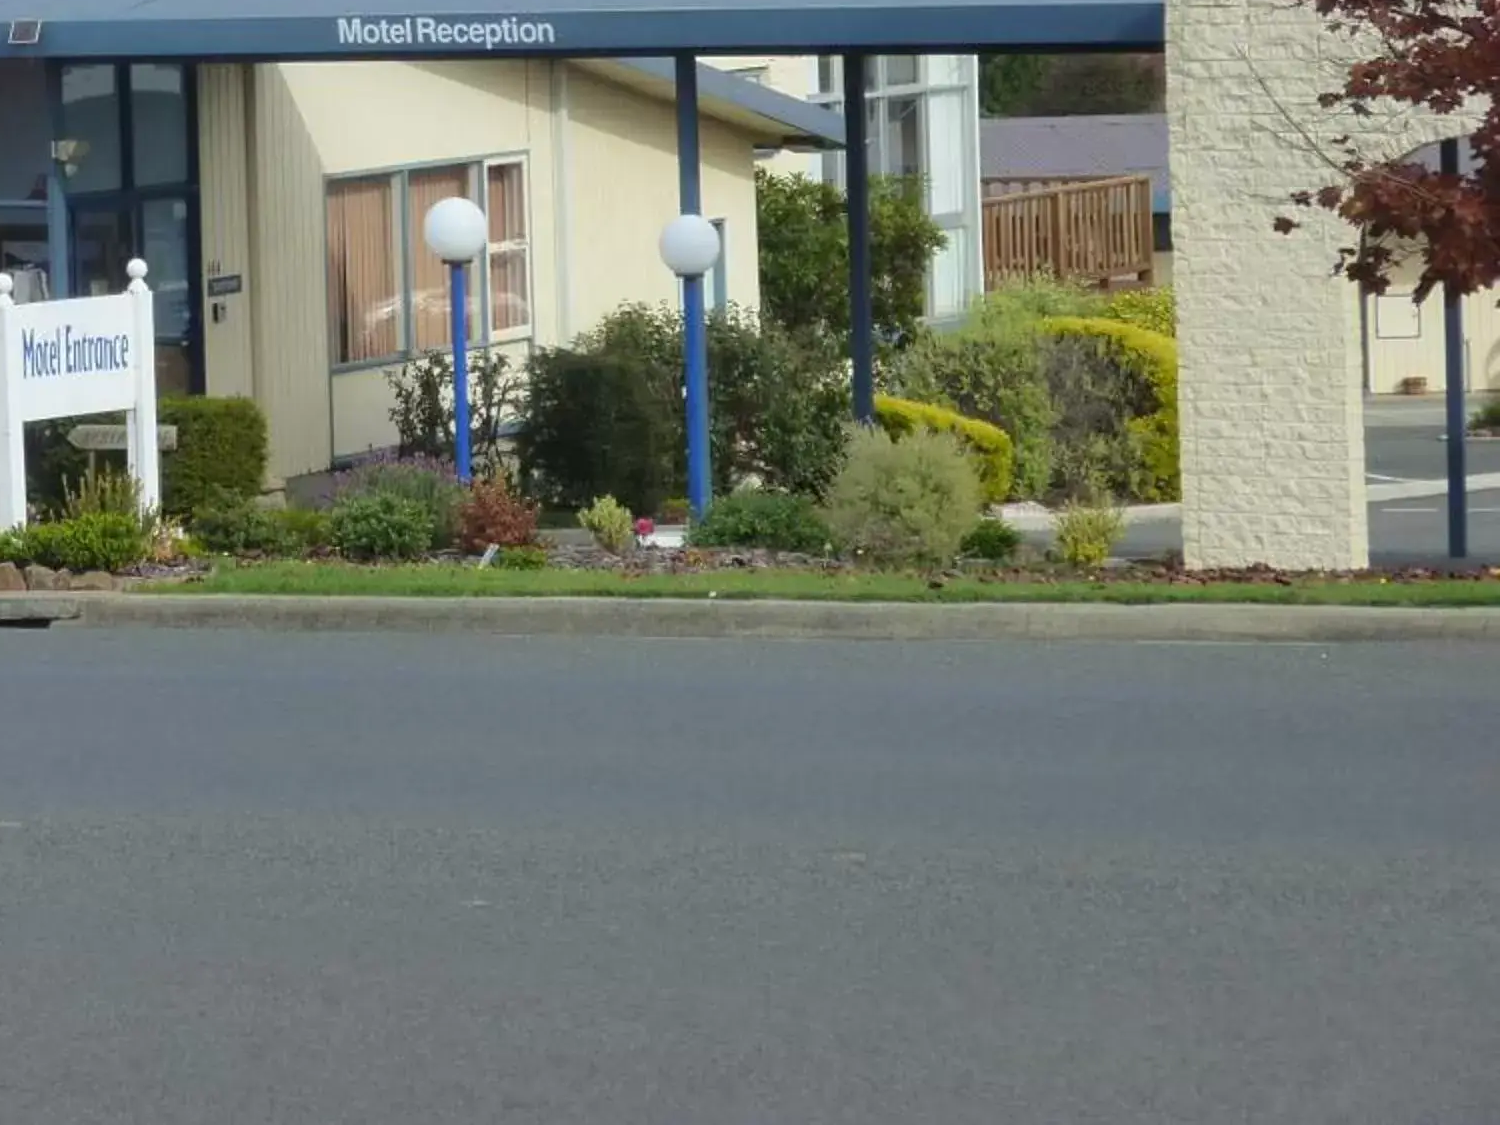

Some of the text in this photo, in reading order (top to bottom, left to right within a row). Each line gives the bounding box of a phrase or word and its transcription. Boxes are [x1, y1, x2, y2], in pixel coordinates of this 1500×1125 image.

[336, 15, 556, 50] Motel Reception
[22, 324, 130, 379] Motel Entrance
